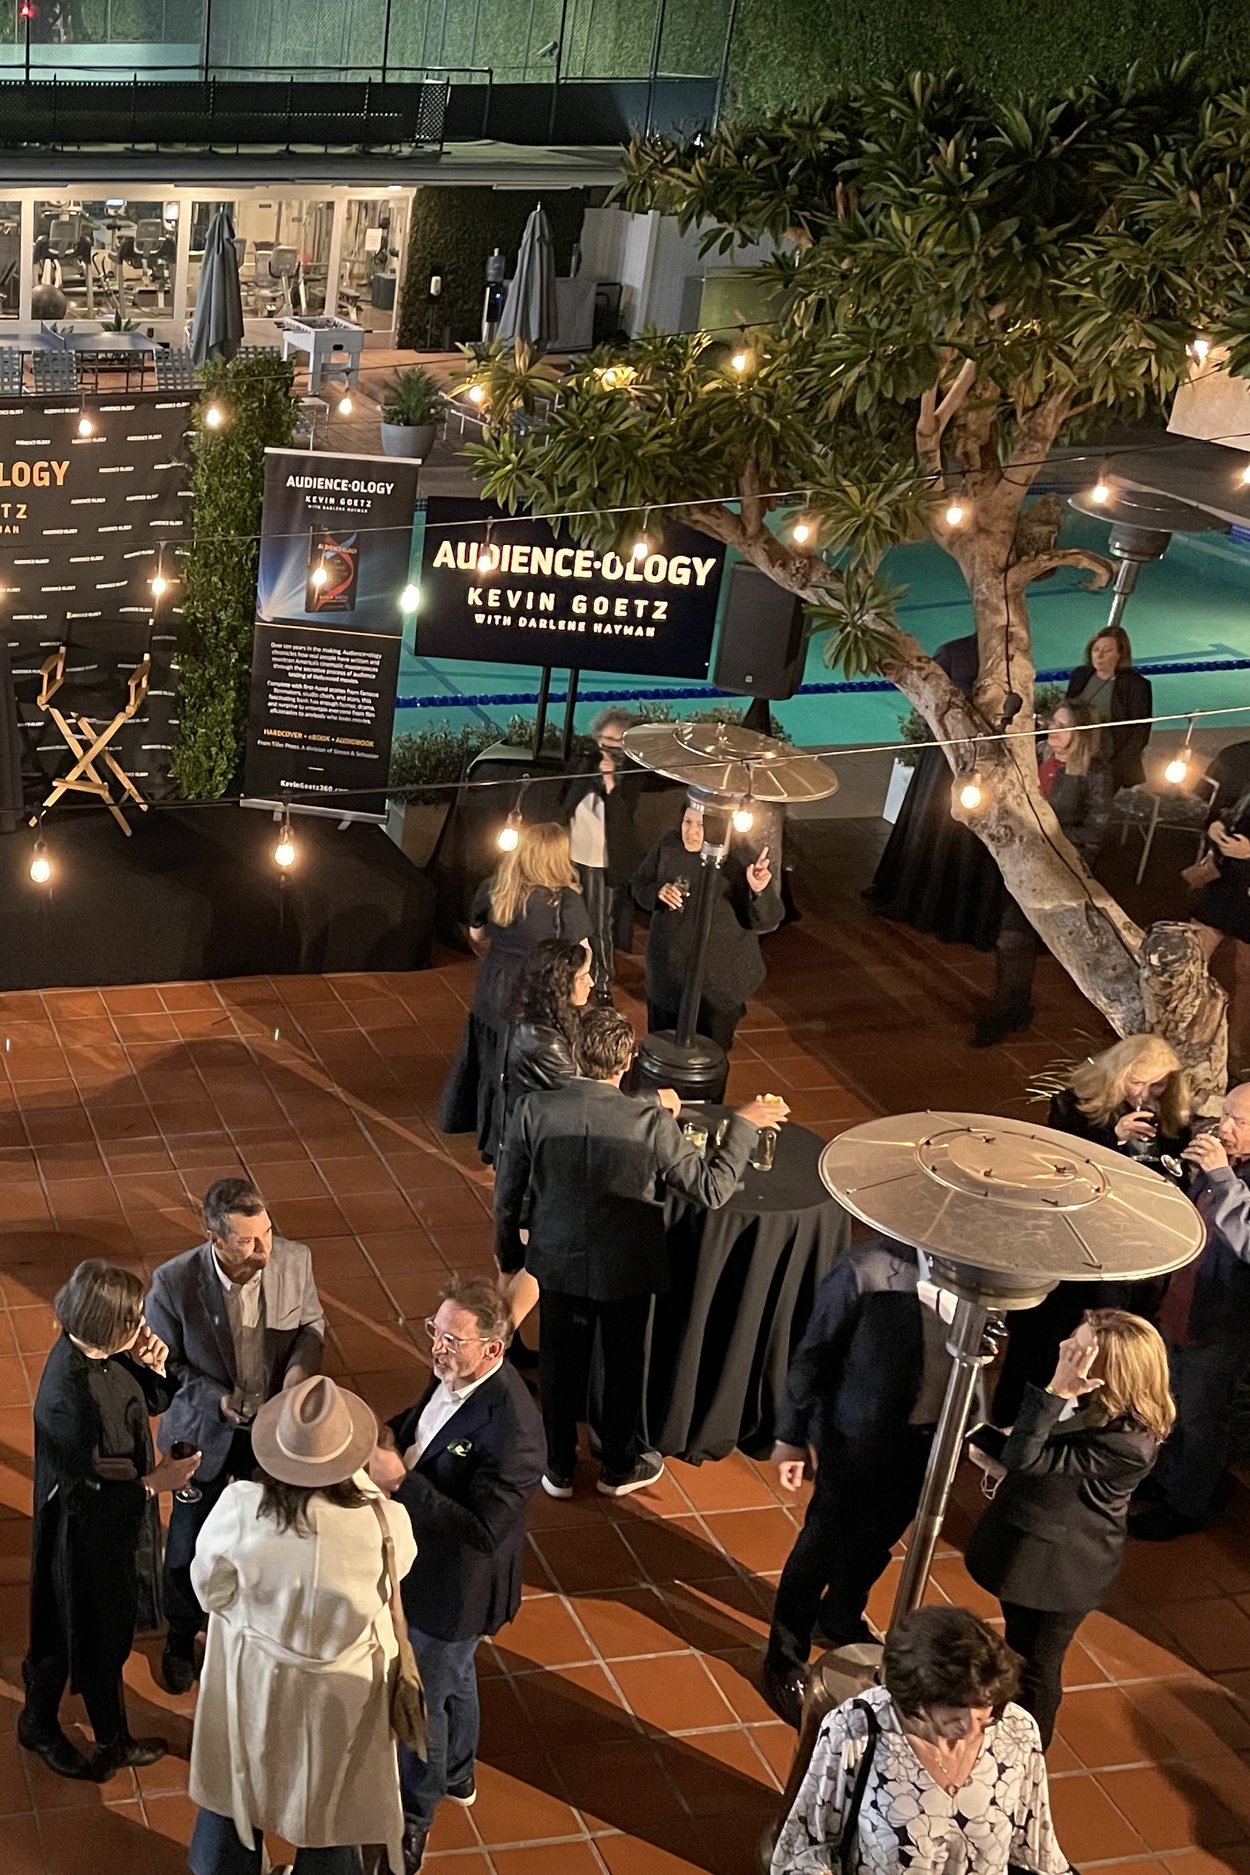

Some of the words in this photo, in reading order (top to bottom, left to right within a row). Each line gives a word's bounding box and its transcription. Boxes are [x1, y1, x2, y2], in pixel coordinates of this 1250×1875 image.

[305, 496, 335, 504] KEVIN
[340, 498, 372, 507] GOETZ
[468, 587, 555, 611] KEVIN
[572, 595, 669, 620] GOETZ
[474, 613, 511, 626] WITH
[519, 616, 586, 632] DARLENE
[593, 622, 656, 637] HAYMAN
